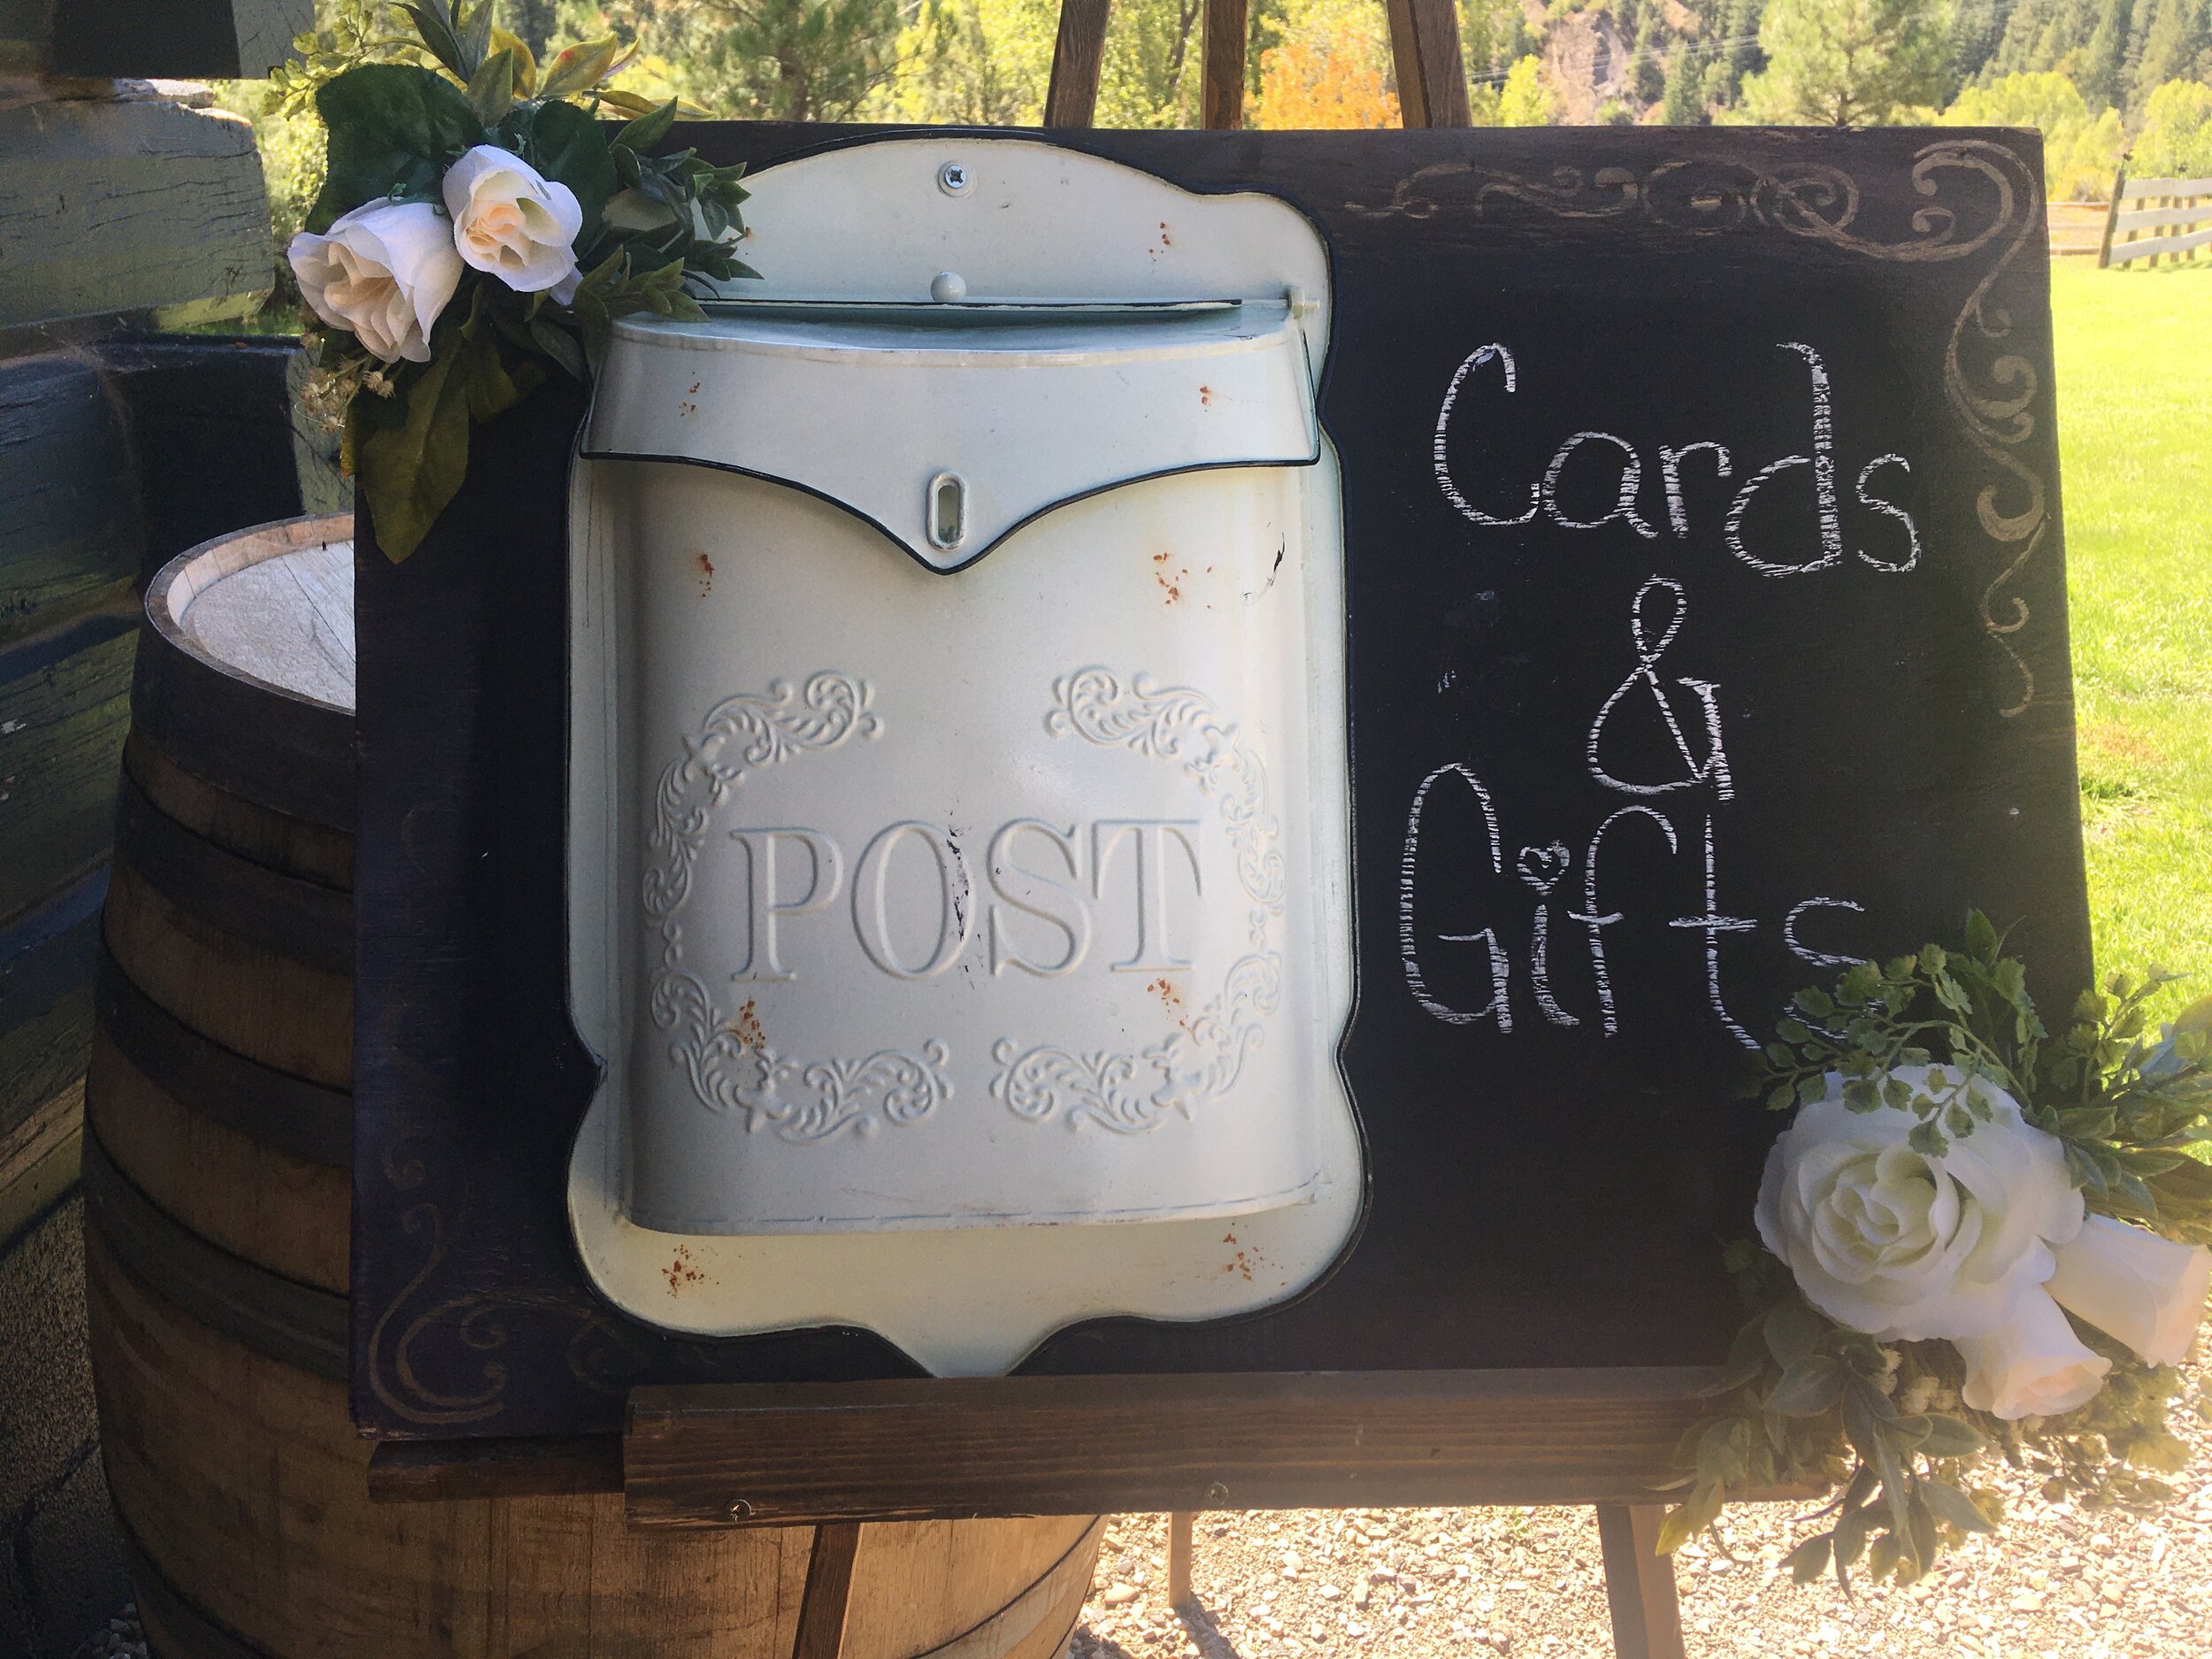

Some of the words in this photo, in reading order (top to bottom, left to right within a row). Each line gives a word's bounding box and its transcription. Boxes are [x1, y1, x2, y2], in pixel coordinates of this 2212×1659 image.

[1433, 342, 1922, 579] Cards
[1587, 573, 1736, 803] &
[729, 818, 1203, 982] POST
[1400, 763, 1885, 1051] Gifts
